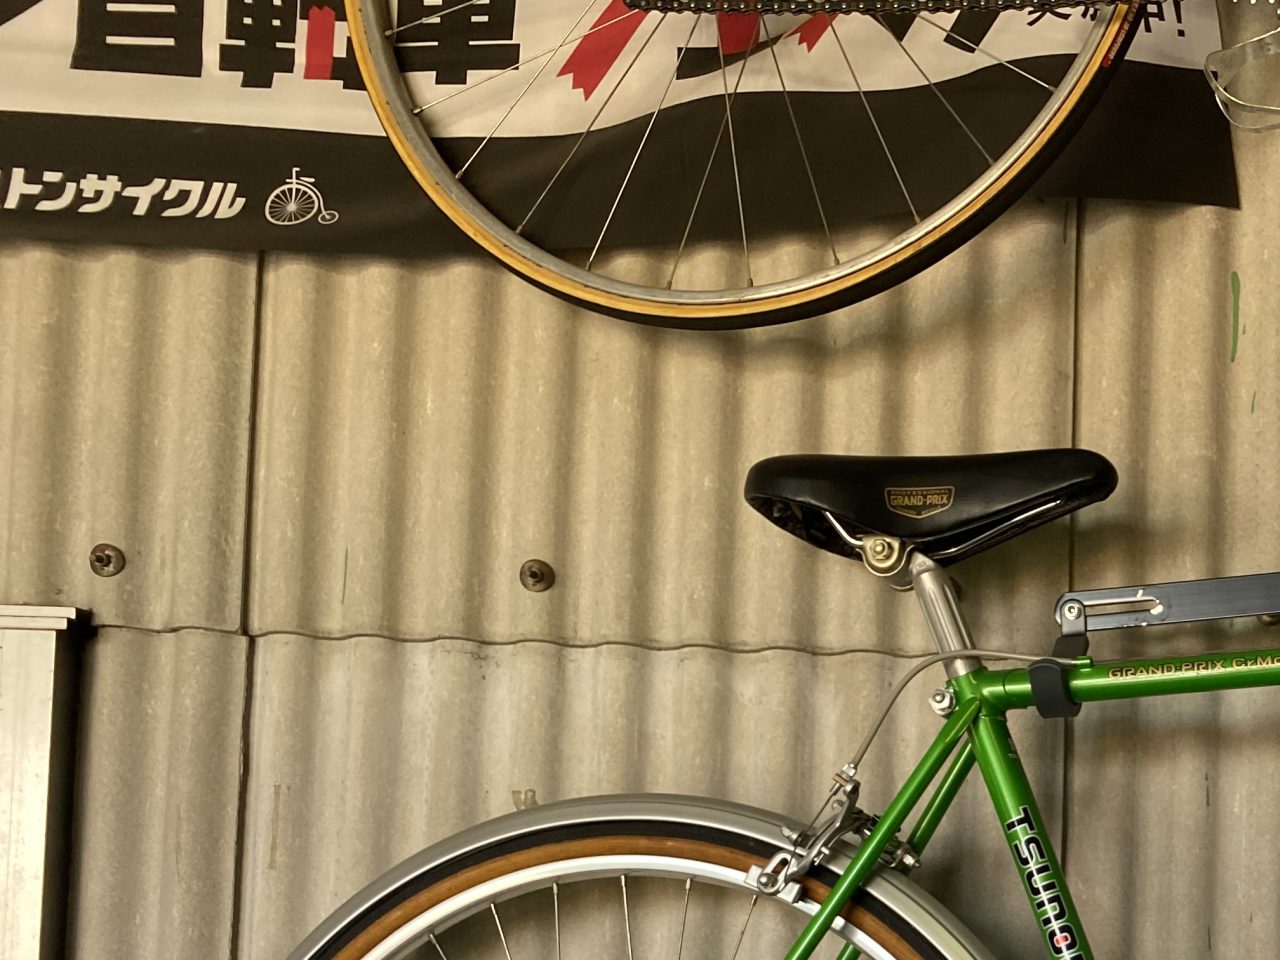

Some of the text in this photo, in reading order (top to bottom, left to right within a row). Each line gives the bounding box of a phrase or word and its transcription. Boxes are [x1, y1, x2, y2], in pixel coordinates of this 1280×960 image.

[0, 167, 246, 219] トンサイクル
